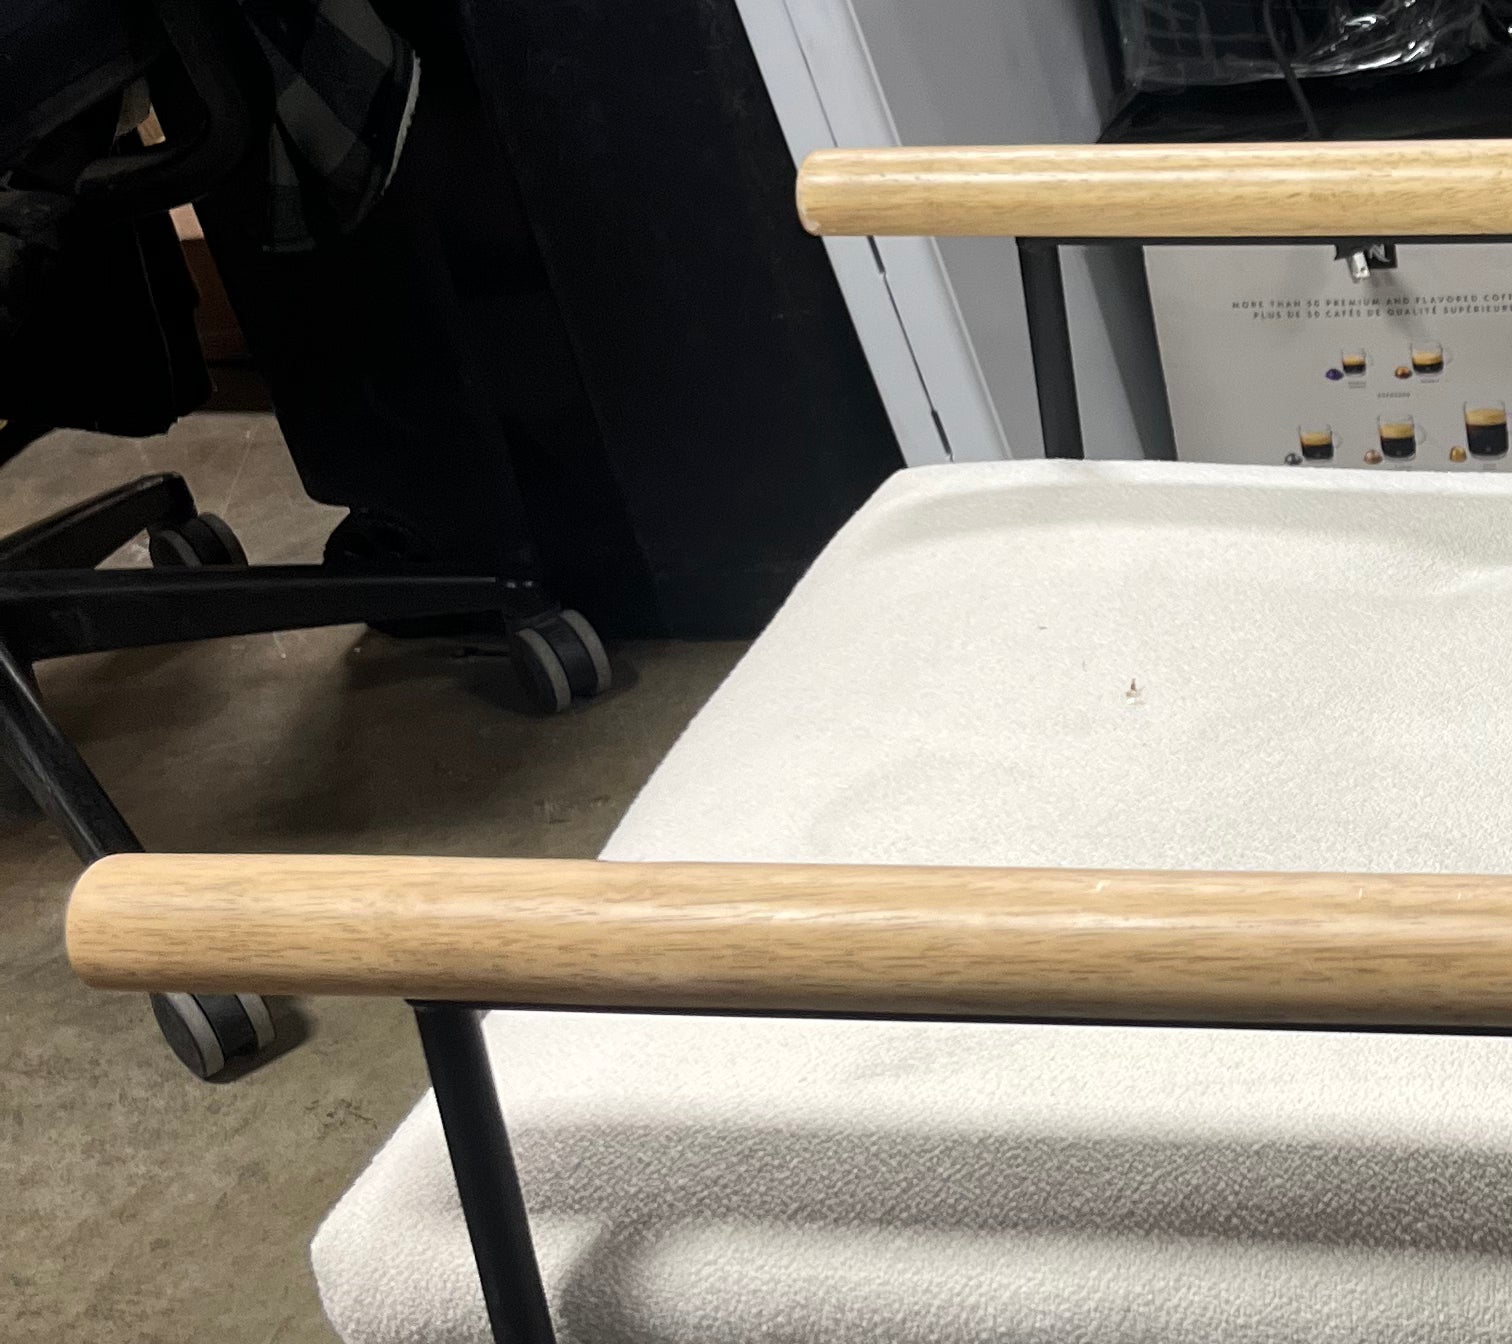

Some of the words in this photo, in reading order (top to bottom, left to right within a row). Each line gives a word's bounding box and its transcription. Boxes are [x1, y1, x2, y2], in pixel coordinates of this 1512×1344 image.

[1325, 298, 1380, 307] PREMIUM
[1386, 296, 1410, 306] AND
[1415, 295, 1478, 305] FLAVORED
